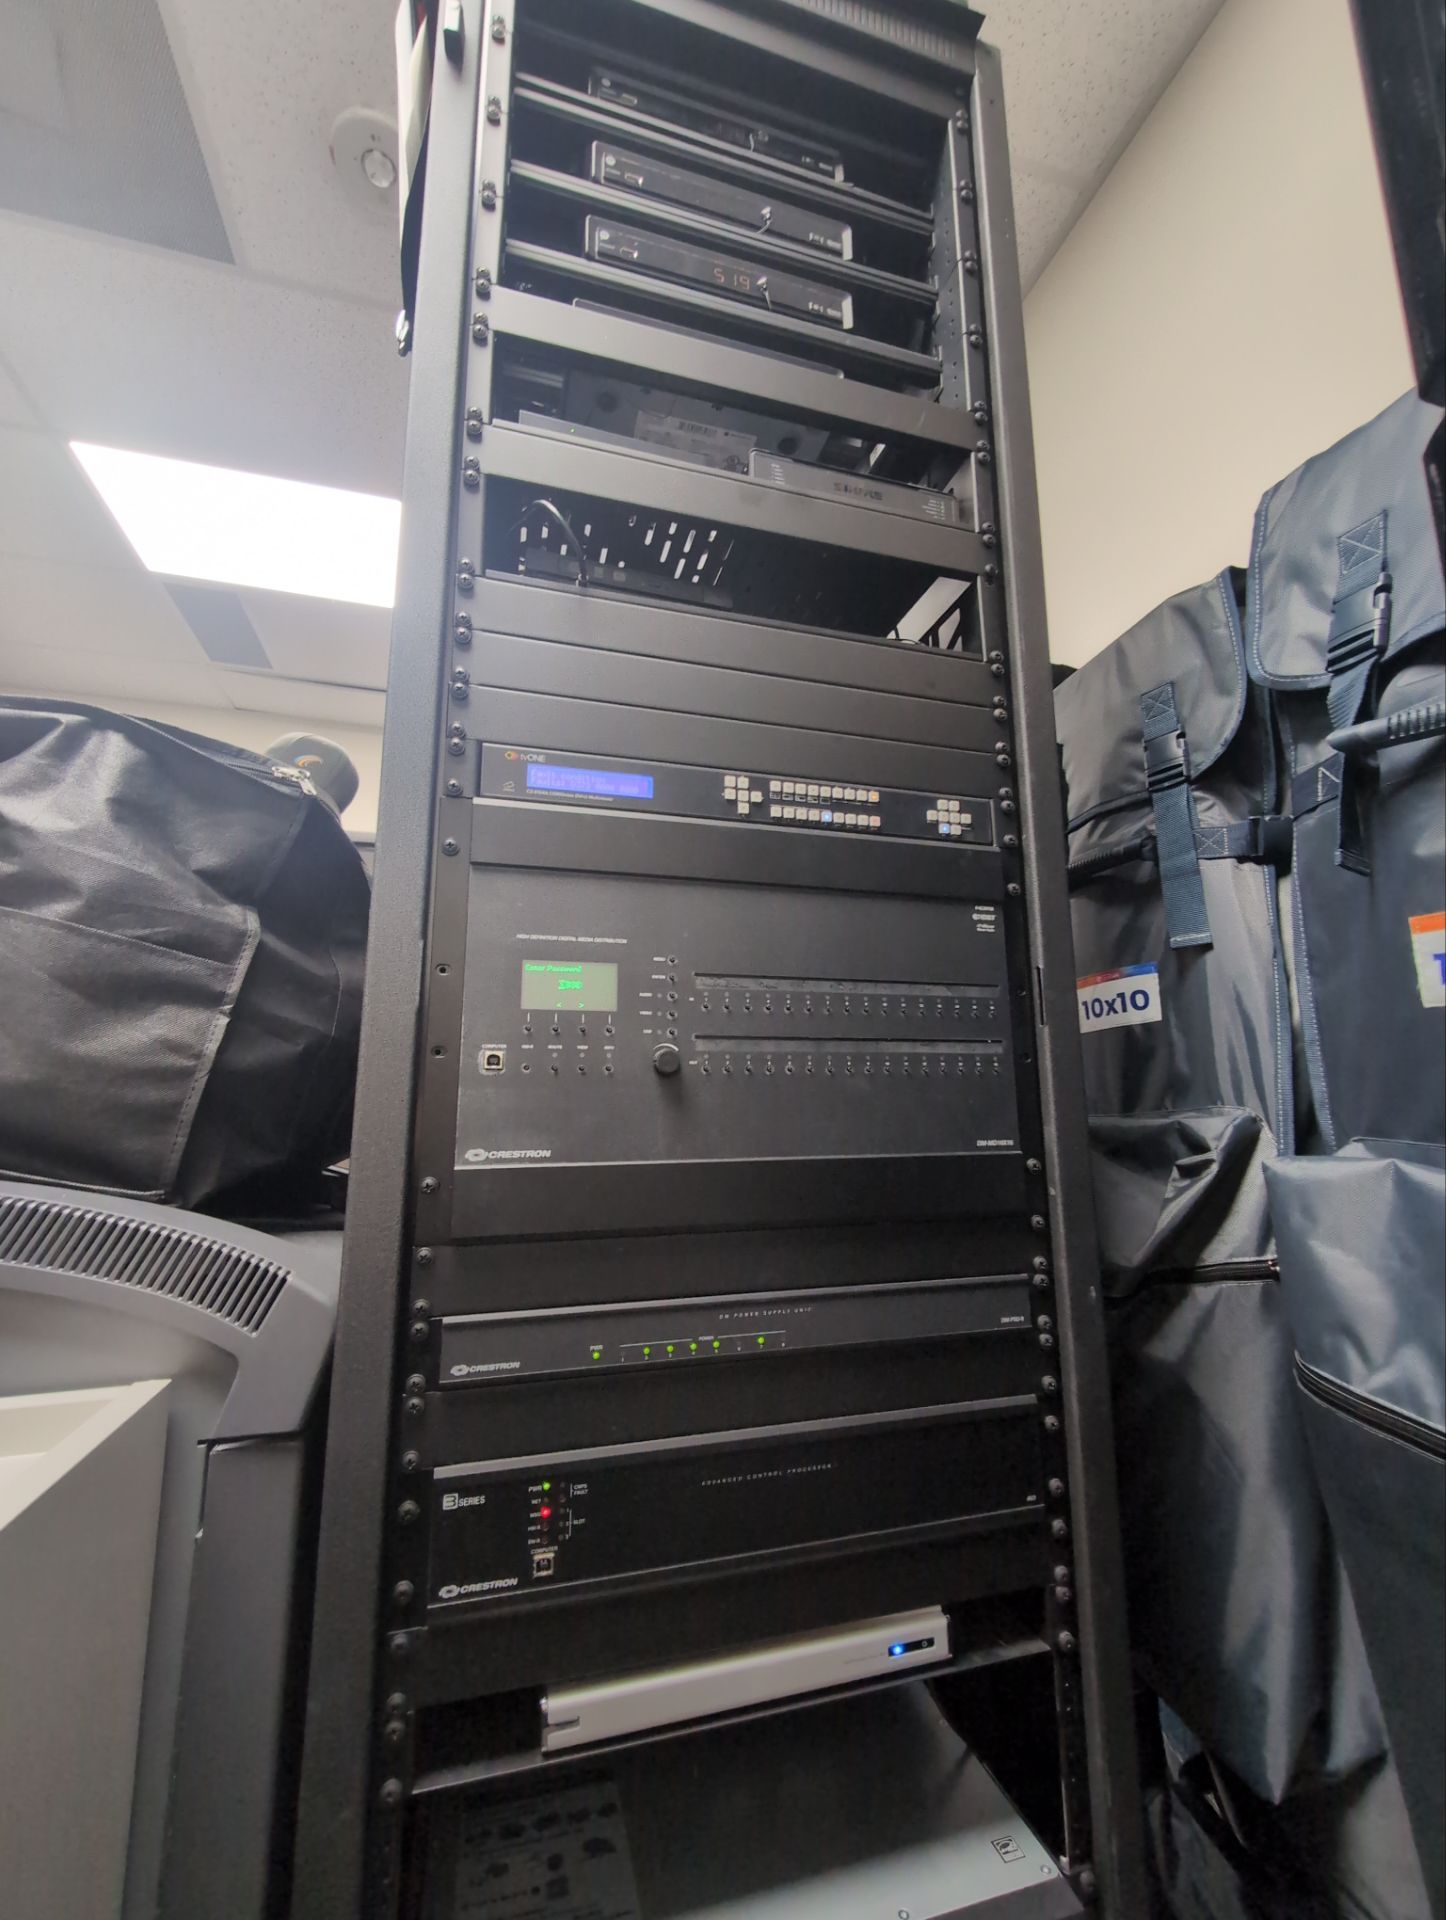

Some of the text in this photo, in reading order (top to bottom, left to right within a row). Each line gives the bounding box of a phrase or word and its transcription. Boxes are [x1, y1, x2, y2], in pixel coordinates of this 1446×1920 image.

[1082, 989, 1150, 1021] 10x10
[488, 1149, 551, 1159] CRESTRON
[469, 1361, 520, 1373] CRESTRON
[459, 1495, 485, 1507] SERIES
[460, 1578, 519, 1594] CRESTRON
